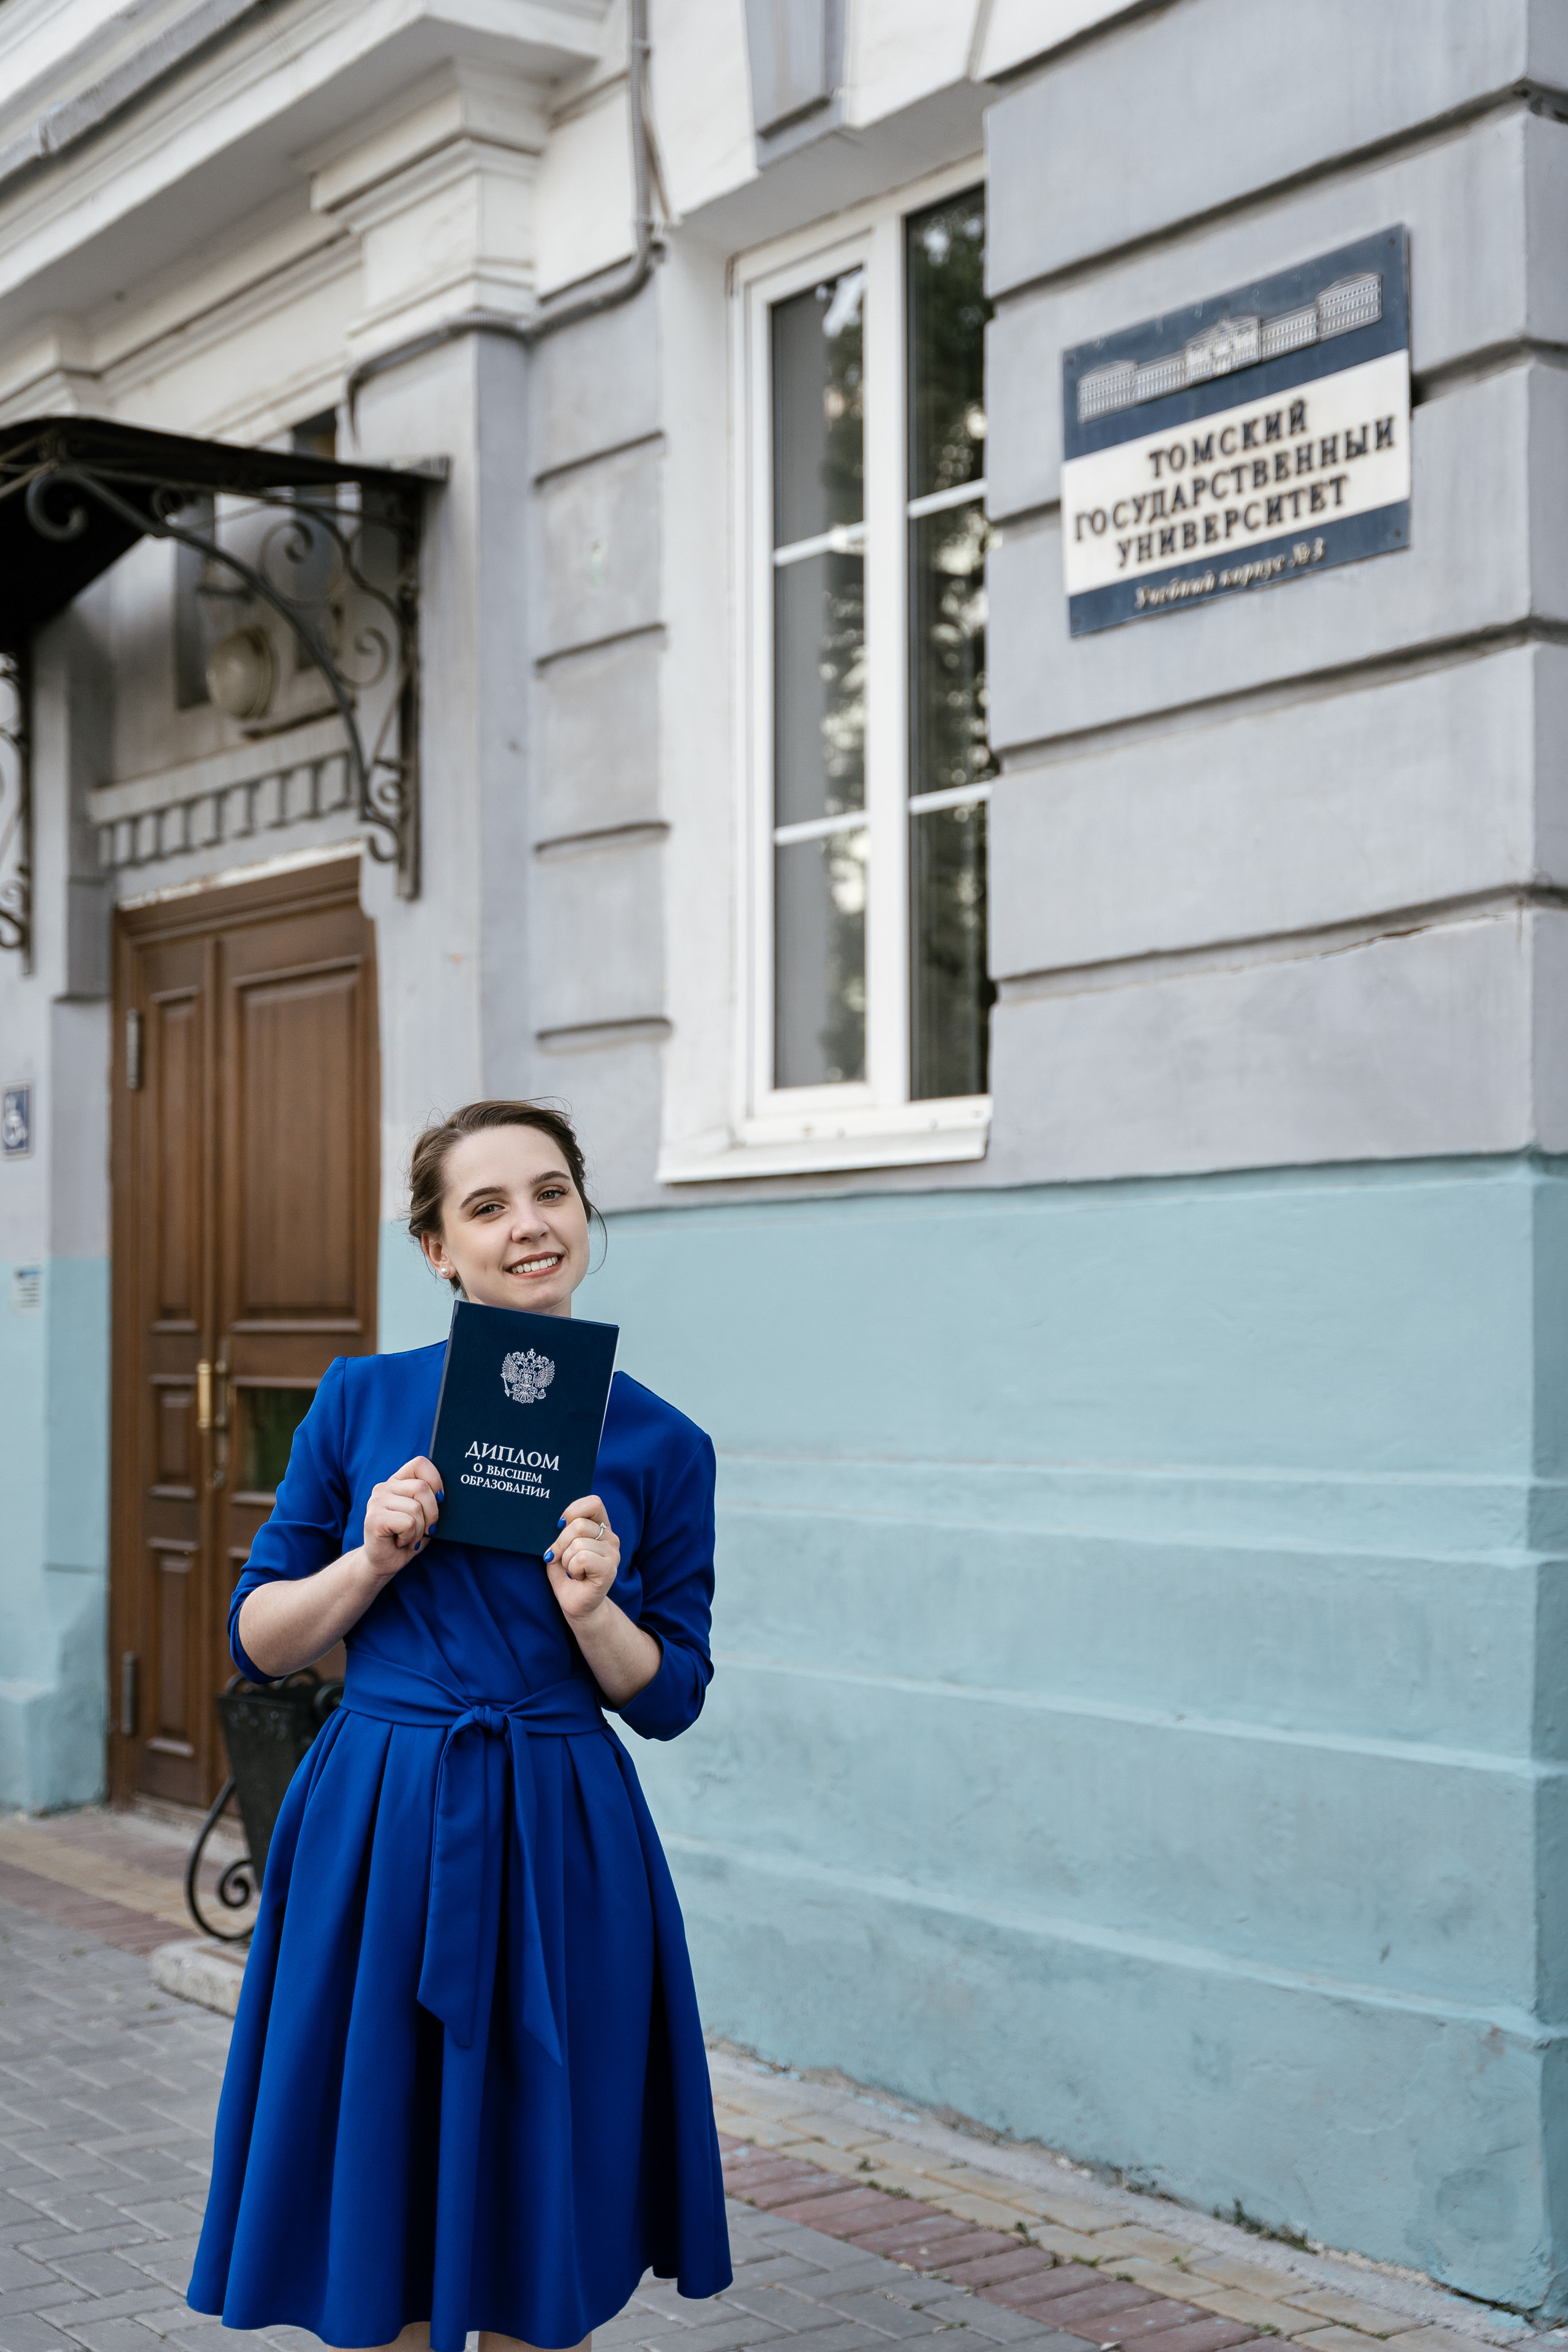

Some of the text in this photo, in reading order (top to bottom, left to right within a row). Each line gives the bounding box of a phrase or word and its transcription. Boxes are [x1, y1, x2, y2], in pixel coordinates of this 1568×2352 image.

[1148, 398, 1308, 478] ТОМСКИЙ
[1116, 474, 1349, 568] УНИВЕРСИТЕТ
[1135, 570, 1216, 610] Учебный
[1218, 554, 1286, 587] корпус
[464, 1441, 560, 1471] ДИПЛОМ
[473, 1463, 543, 1484] О ВЫСШЕМ
[460, 1474, 551, 1499] ОБРАЗОВАНИИ
